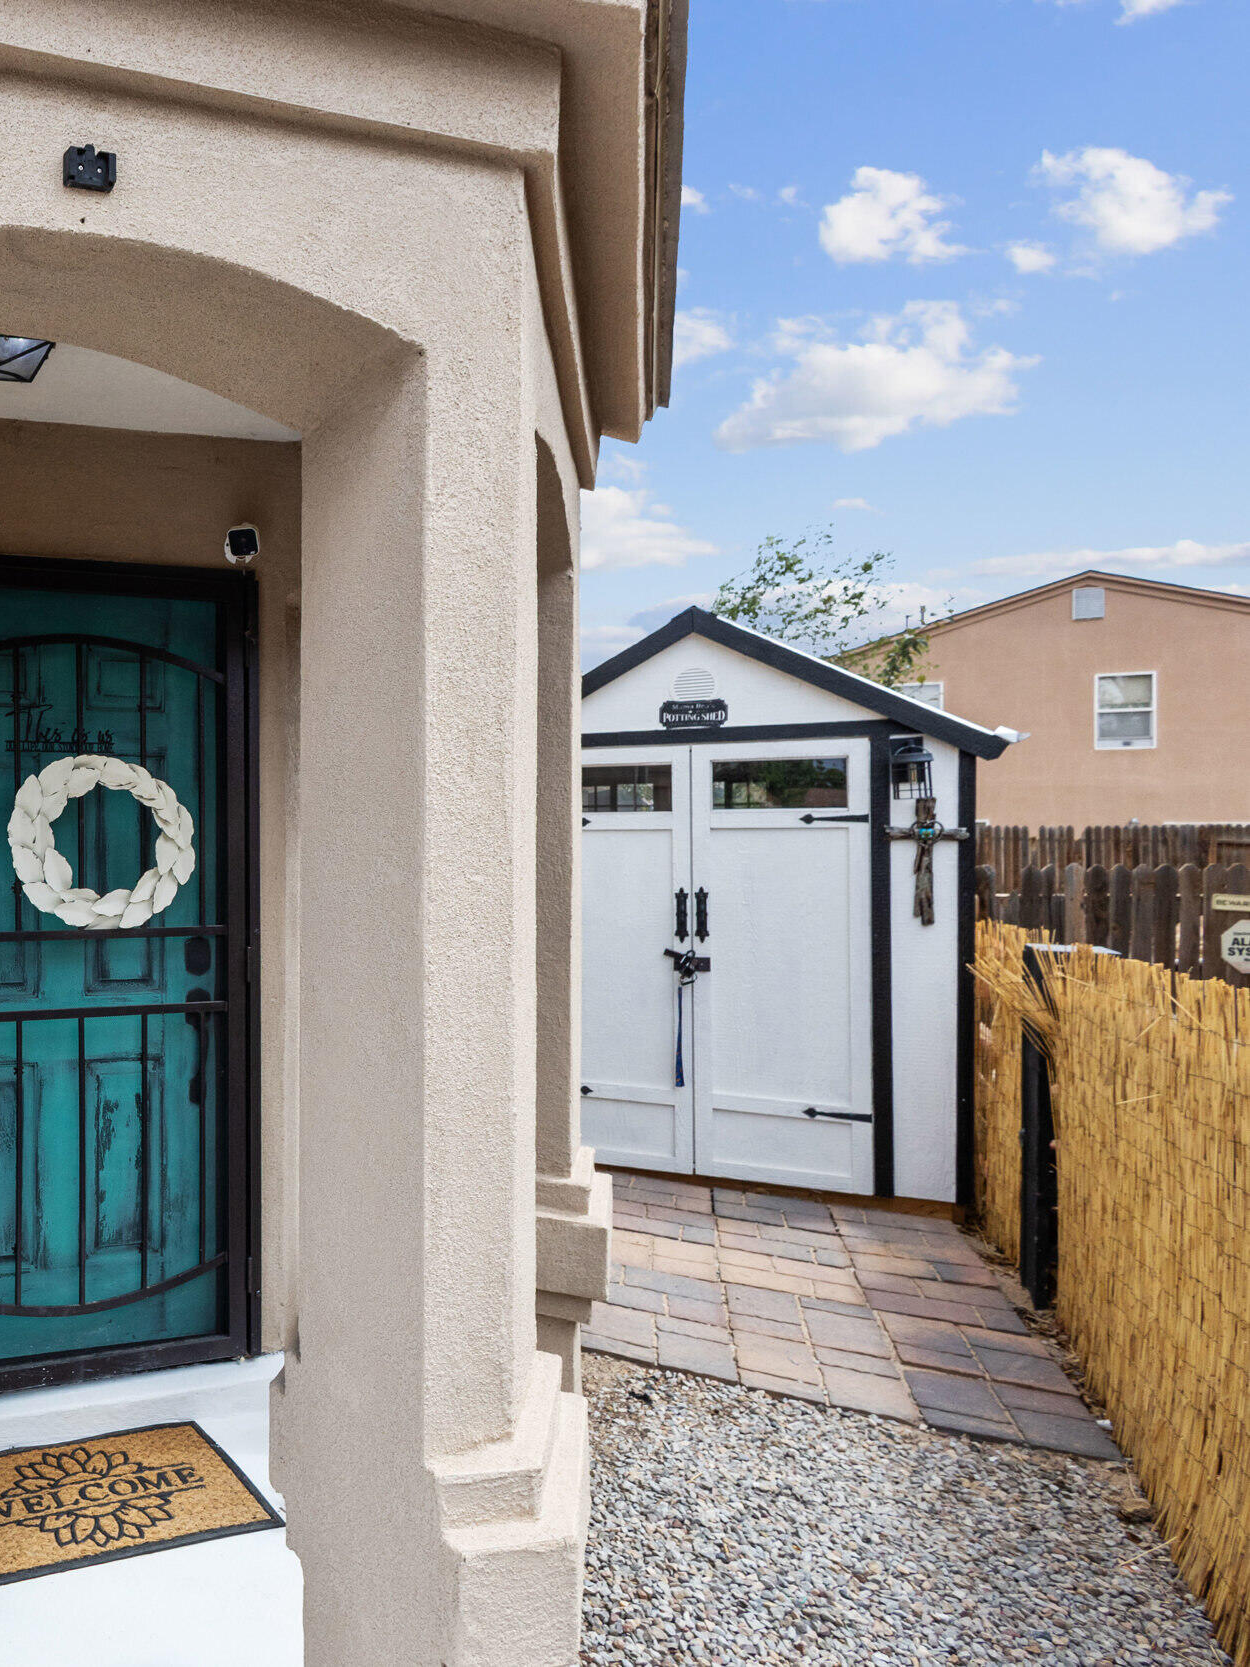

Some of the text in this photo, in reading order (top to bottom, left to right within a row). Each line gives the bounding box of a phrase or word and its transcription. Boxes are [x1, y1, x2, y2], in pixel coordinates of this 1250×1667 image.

[662, 710, 726, 723] POTTING SHED
[1231, 937, 1250, 946] AL
[1227, 947, 1250, 957] SYS
